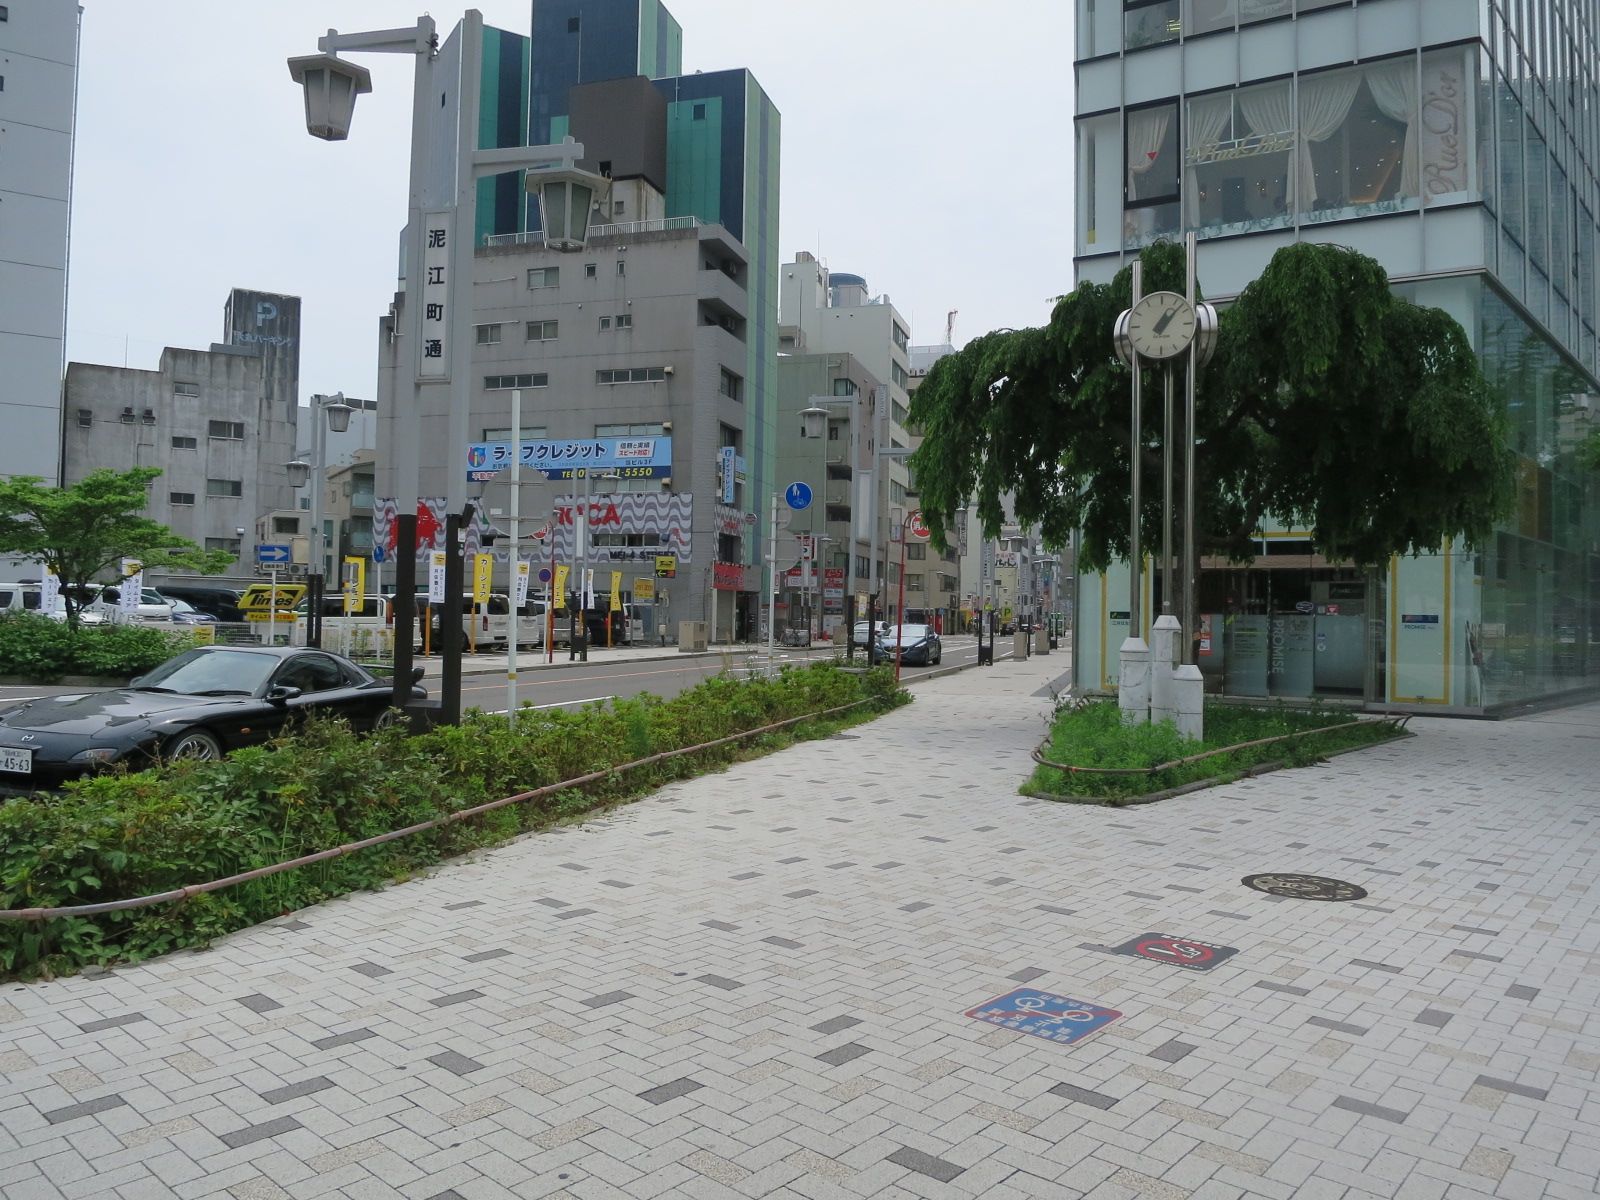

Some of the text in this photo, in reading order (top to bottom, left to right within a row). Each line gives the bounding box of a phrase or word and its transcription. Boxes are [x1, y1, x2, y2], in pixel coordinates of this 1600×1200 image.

[424, 229, 446, 358] 泥江町通
[256, 302, 277, 327] P
[492, 442, 607, 461] ラフクレジット
[480, 558, 488, 598] カーシェア
[1271, 619, 1285, 674] PROMISE
[4, 757, 30, 771] 45-63
